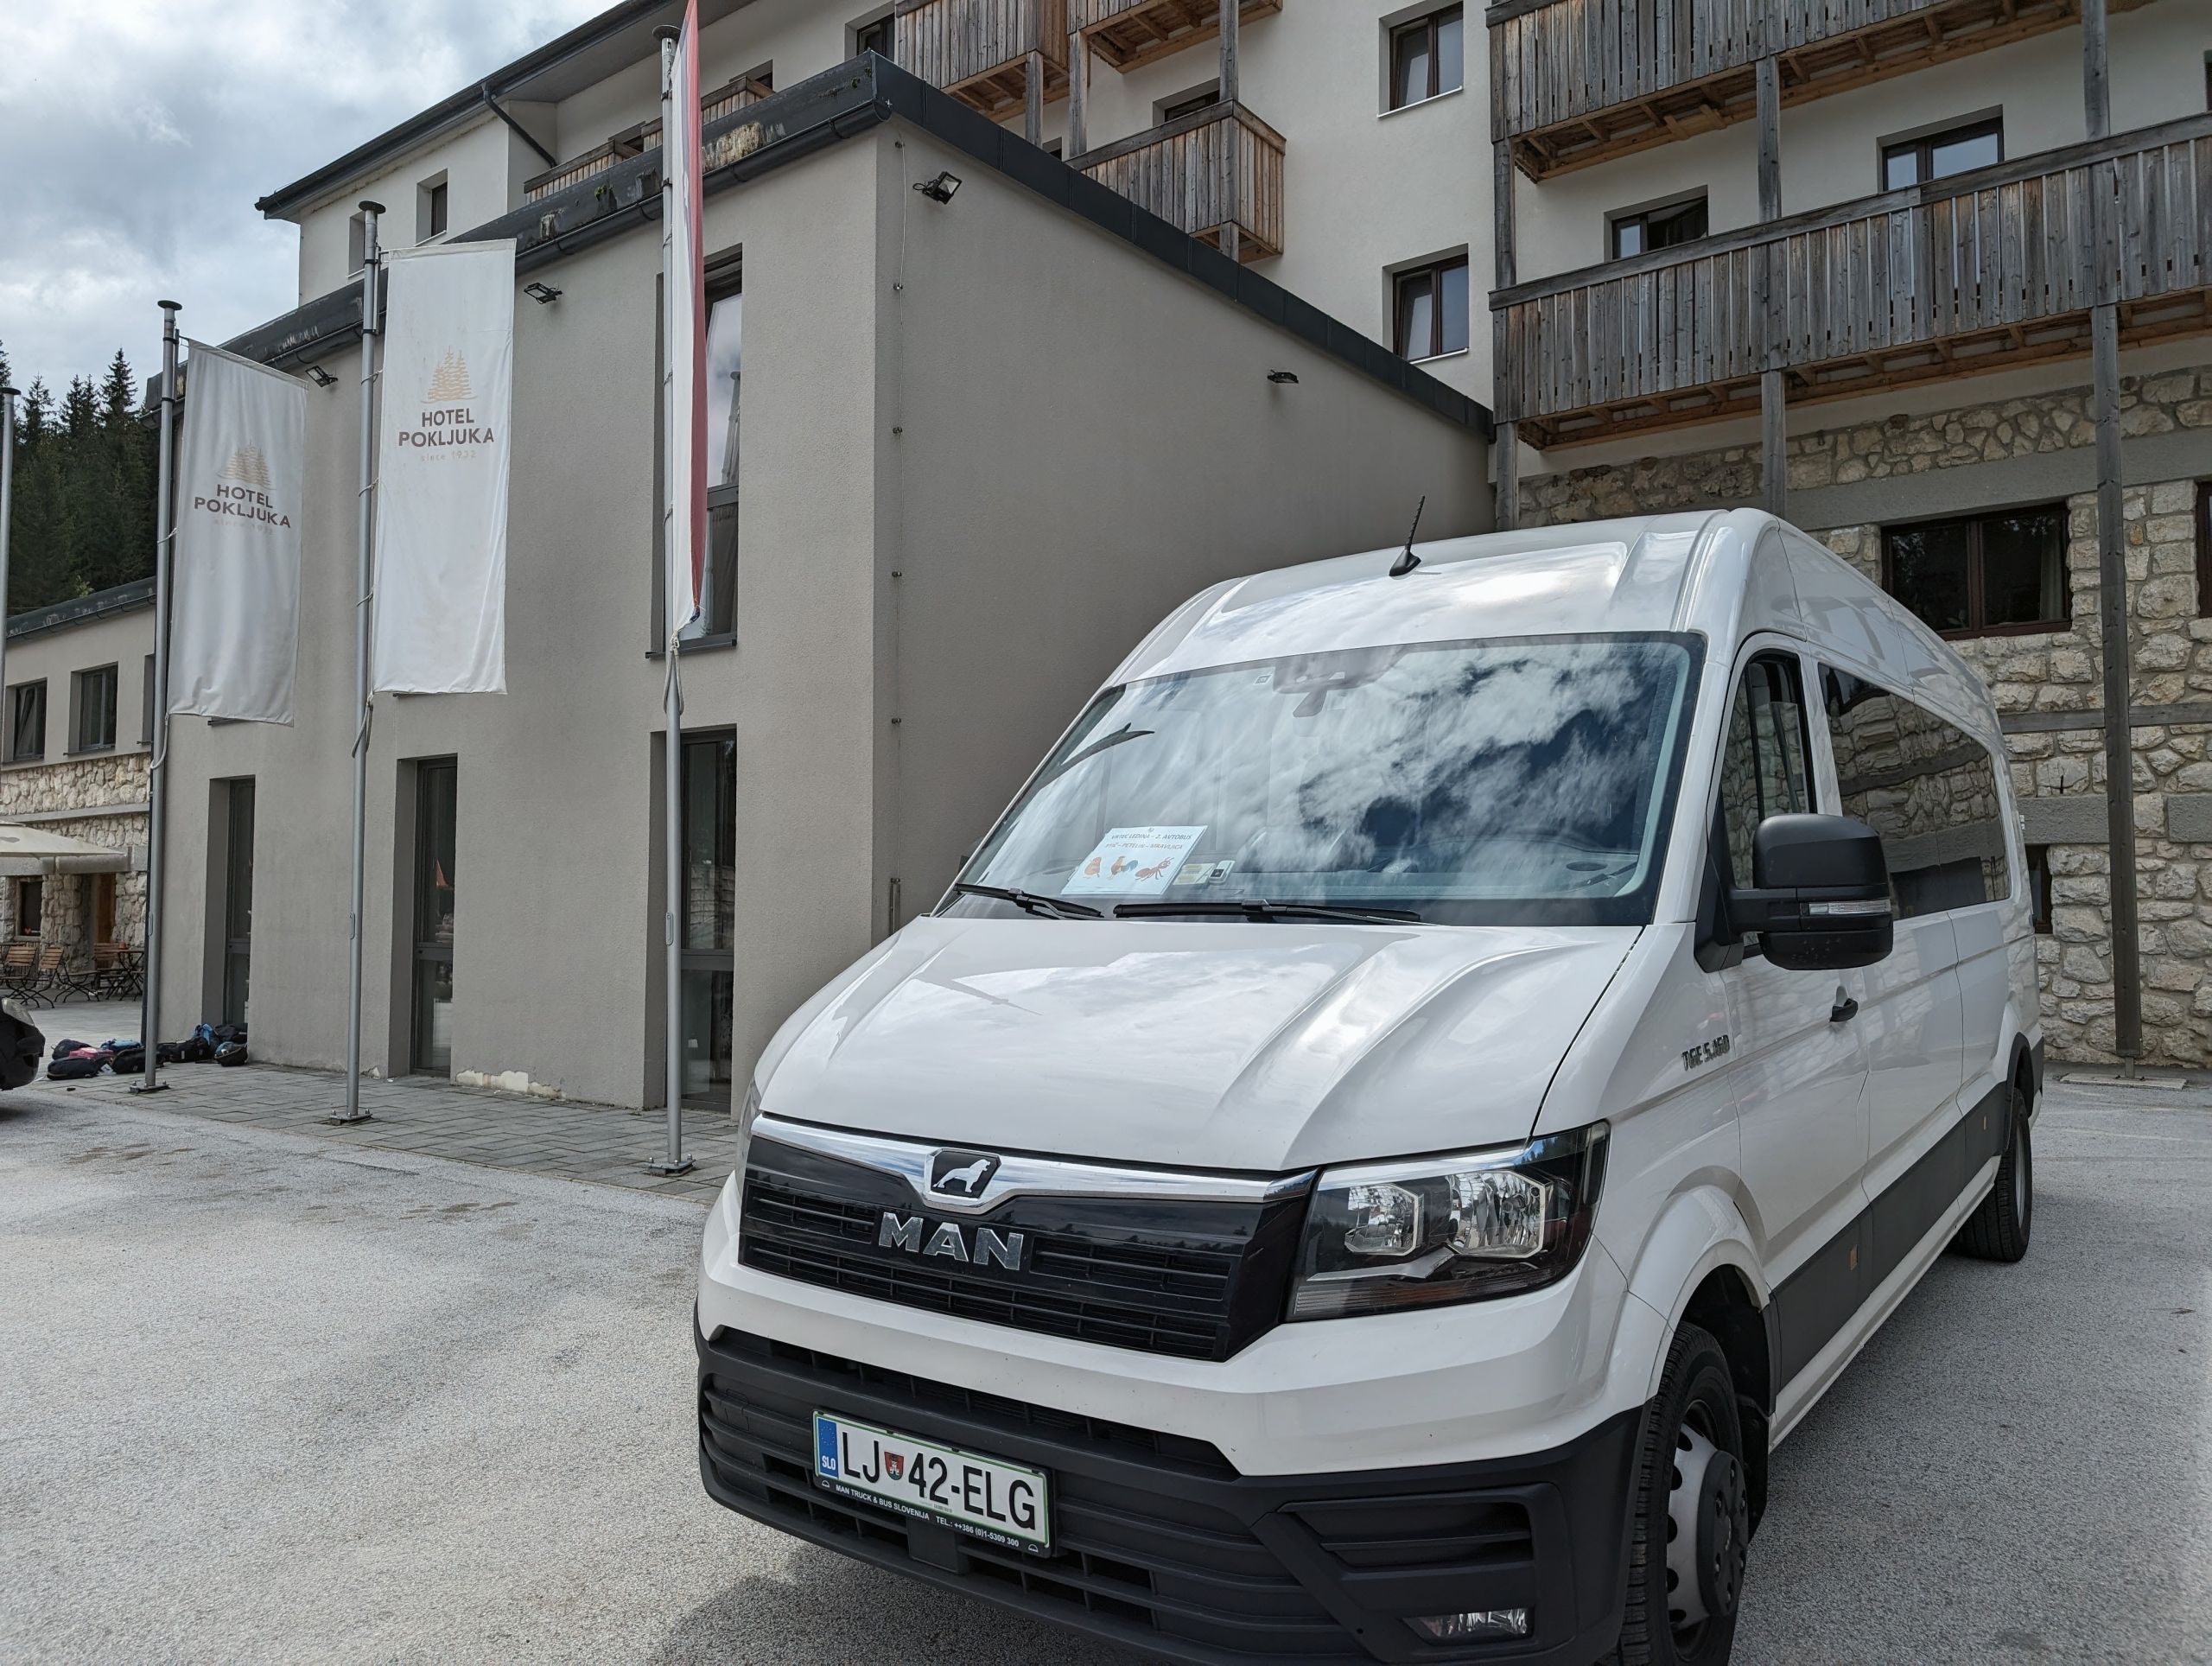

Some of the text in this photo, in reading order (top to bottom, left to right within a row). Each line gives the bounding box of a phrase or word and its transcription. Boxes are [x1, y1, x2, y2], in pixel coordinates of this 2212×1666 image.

[422, 408, 474, 427] HOTEL
[398, 428, 494, 447] POKLJUKA
[421, 453, 446, 462] since
[216, 484, 273, 508] HOTEL
[194, 496, 291, 528] POKLJUKA
[1681, 1045, 1703, 1071] TGE
[879, 1211, 1024, 1271] MAN
[822, 1455, 836, 1471] SLO
[842, 1431, 1036, 1530] LJ 42-ELG
[836, 1484, 850, 1495] MAN
[850, 1489, 873, 1502] TRUCK
[879, 1498, 893, 1509] BUS
[893, 1503, 930, 1521] SLOVENIJA
[1007, 1536, 1020, 1548] 300
